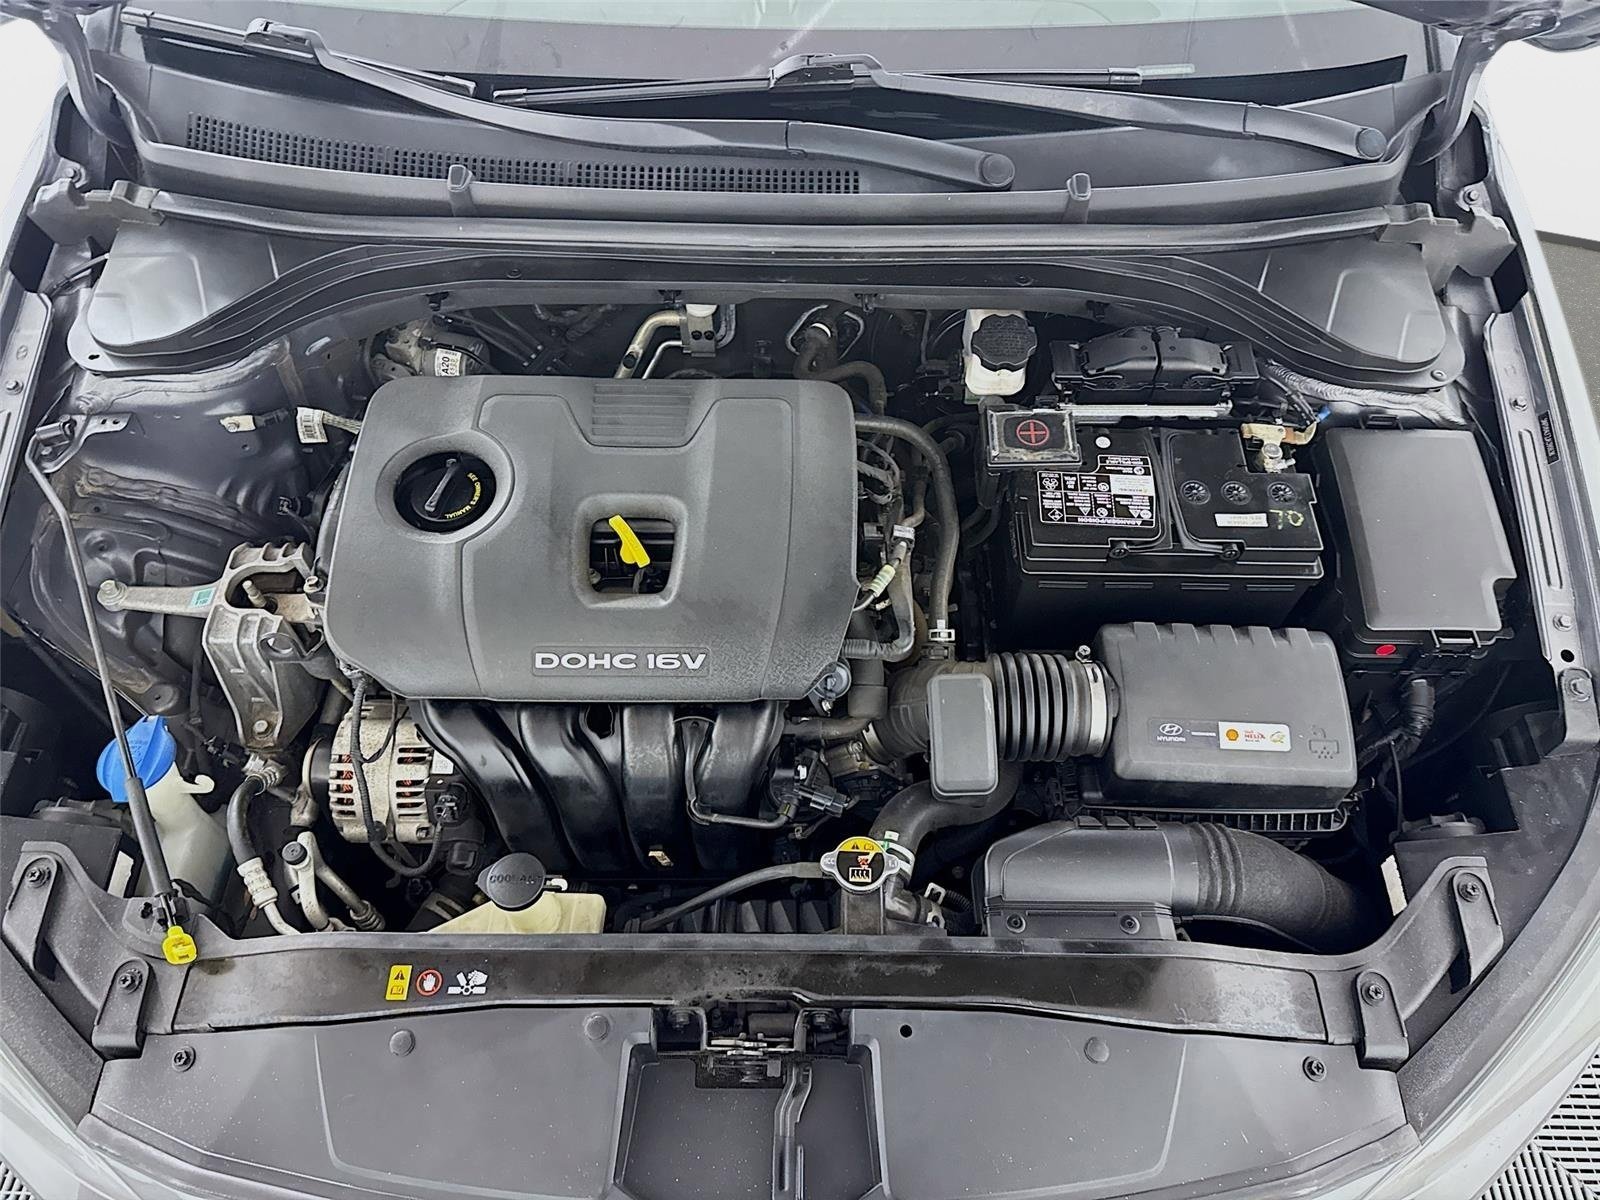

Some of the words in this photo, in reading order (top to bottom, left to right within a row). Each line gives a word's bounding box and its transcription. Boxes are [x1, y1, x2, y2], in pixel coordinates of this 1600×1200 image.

[442, 356, 450, 375] A20
[445, 505, 472, 519] MANUAL
[535, 653, 637, 669] DOHC
[647, 653, 707, 669] 16V
